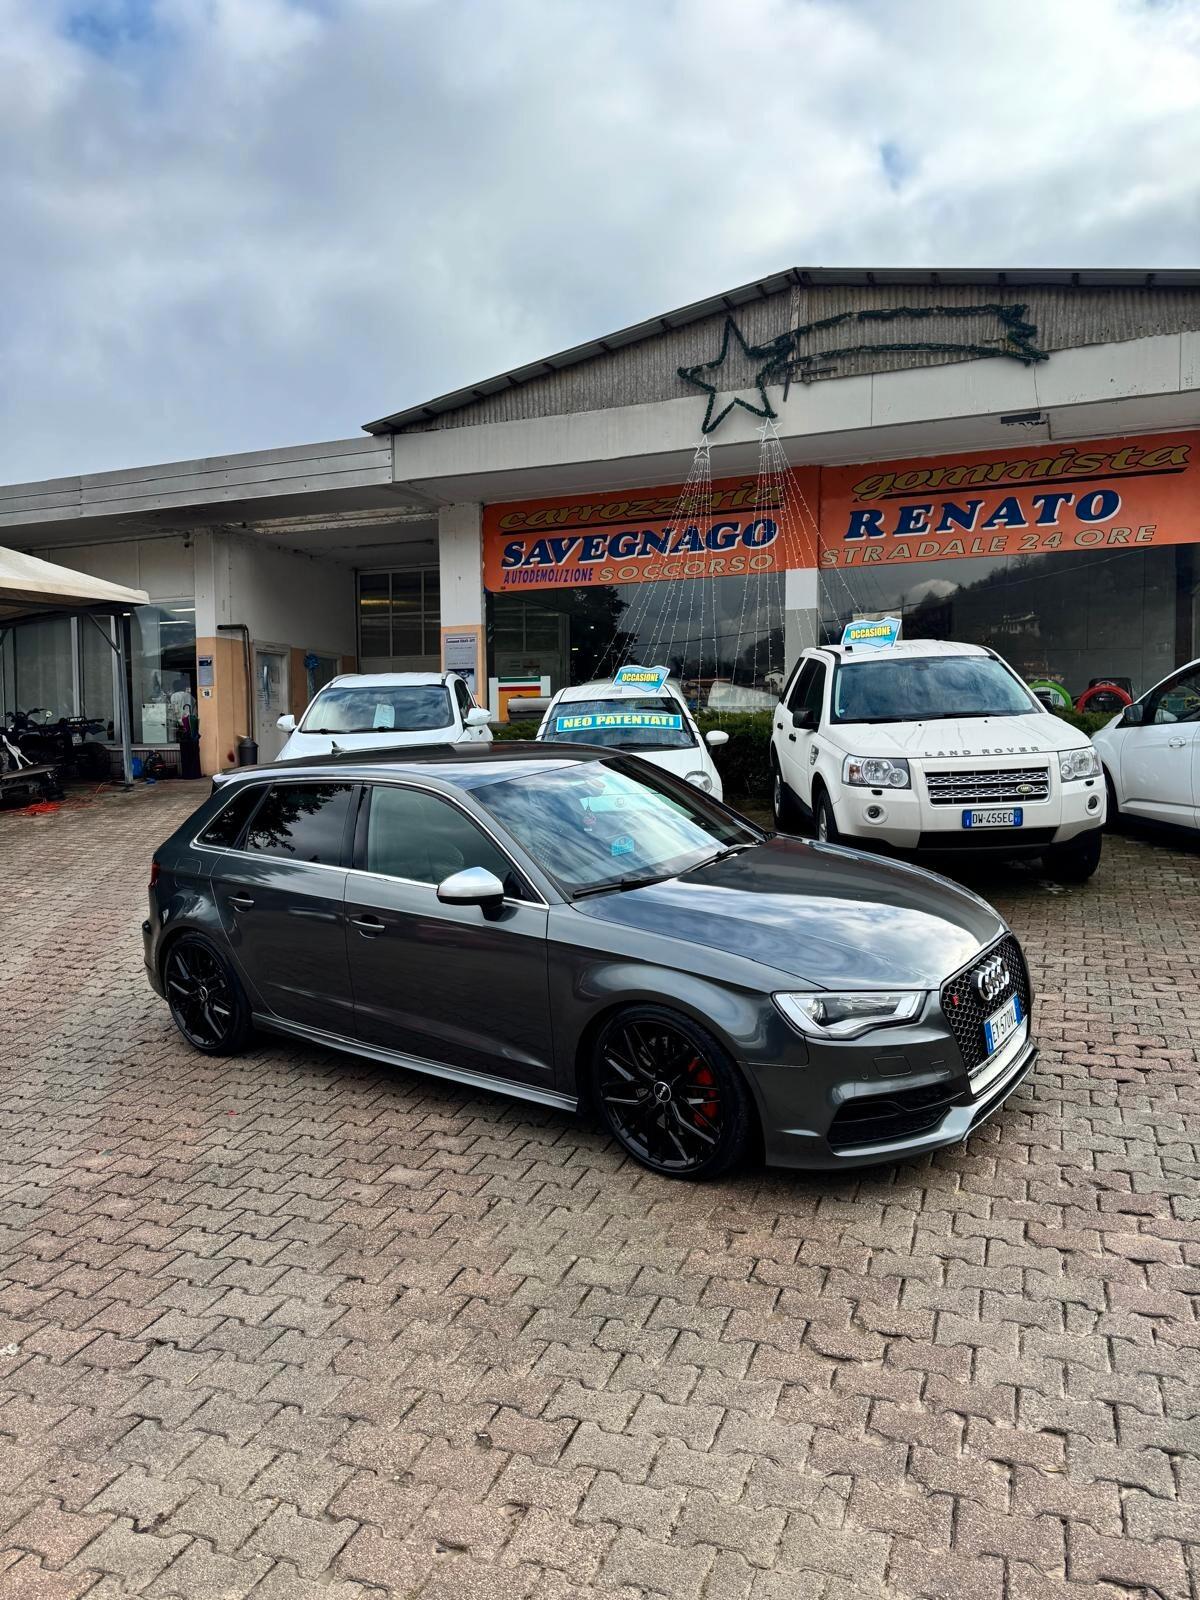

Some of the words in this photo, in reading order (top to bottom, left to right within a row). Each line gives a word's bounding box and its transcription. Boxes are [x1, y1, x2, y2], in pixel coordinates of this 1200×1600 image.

[851, 444, 1192, 501] gommista
[499, 481, 786, 529] carrozzeria
[843, 489, 1122, 541] RENATO
[501, 517, 779, 569] SAVEGNAGO
[820, 536, 1009, 566] STRADALE
[1021, 532, 1064, 549] 24
[1073, 525, 1157, 547] ORE
[503, 567, 594, 584] AUTODEMOLIZIONE
[599, 554, 775, 582] SOCCORSO
[850, 625, 891, 640] OCCASIONE
[621, 672, 660, 683] OCCASIONE
[563, 716, 593, 728] NEO
[596, 715, 674, 726] PATENTATI
[924, 749, 972, 757] LAND
[981, 746, 1040, 755] ROVER
